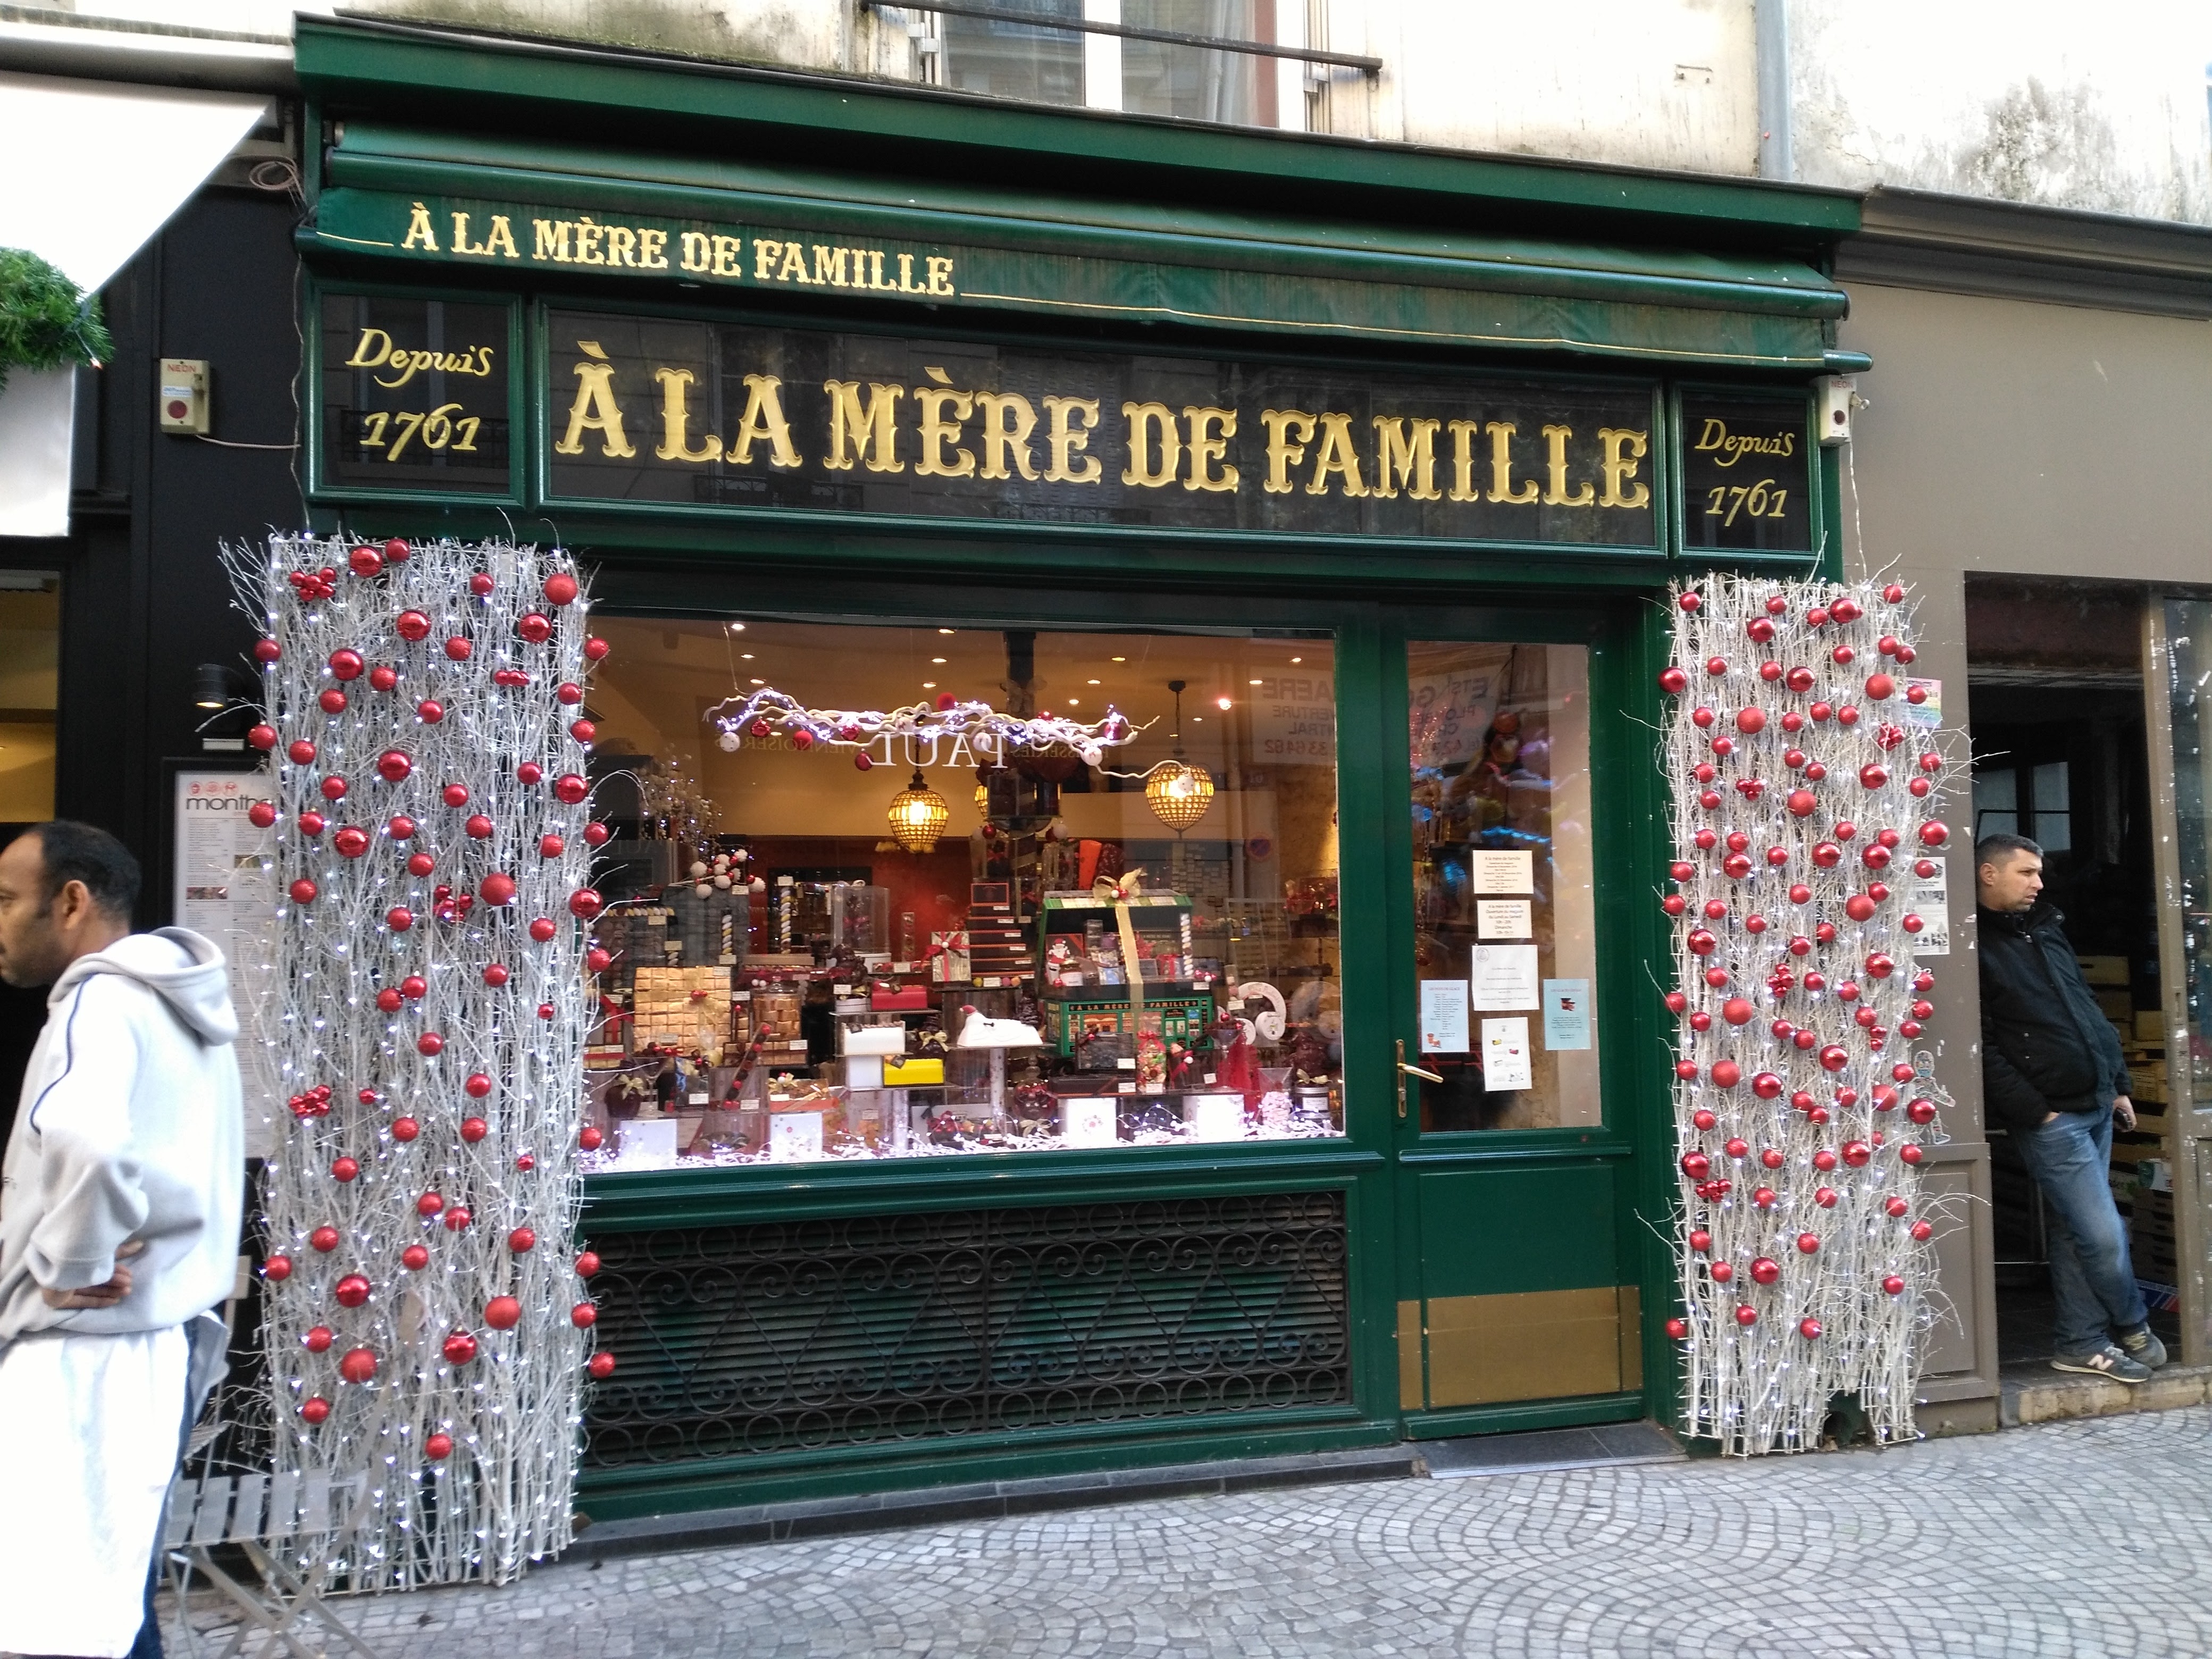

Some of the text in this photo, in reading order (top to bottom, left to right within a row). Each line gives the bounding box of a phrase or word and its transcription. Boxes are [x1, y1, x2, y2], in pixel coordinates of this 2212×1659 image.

[401, 202, 956, 297] À LA MÈRE DE FAMILLE
[167, 364, 196, 372] NEON
[346, 328, 494, 388] Depuis
[361, 403, 481, 462] 1761
[555, 341, 1650, 509] À LA MÈRE DE FAMILLE
[1695, 418, 1793, 468] Depuis
[1707, 479, 1787, 527] 1761
